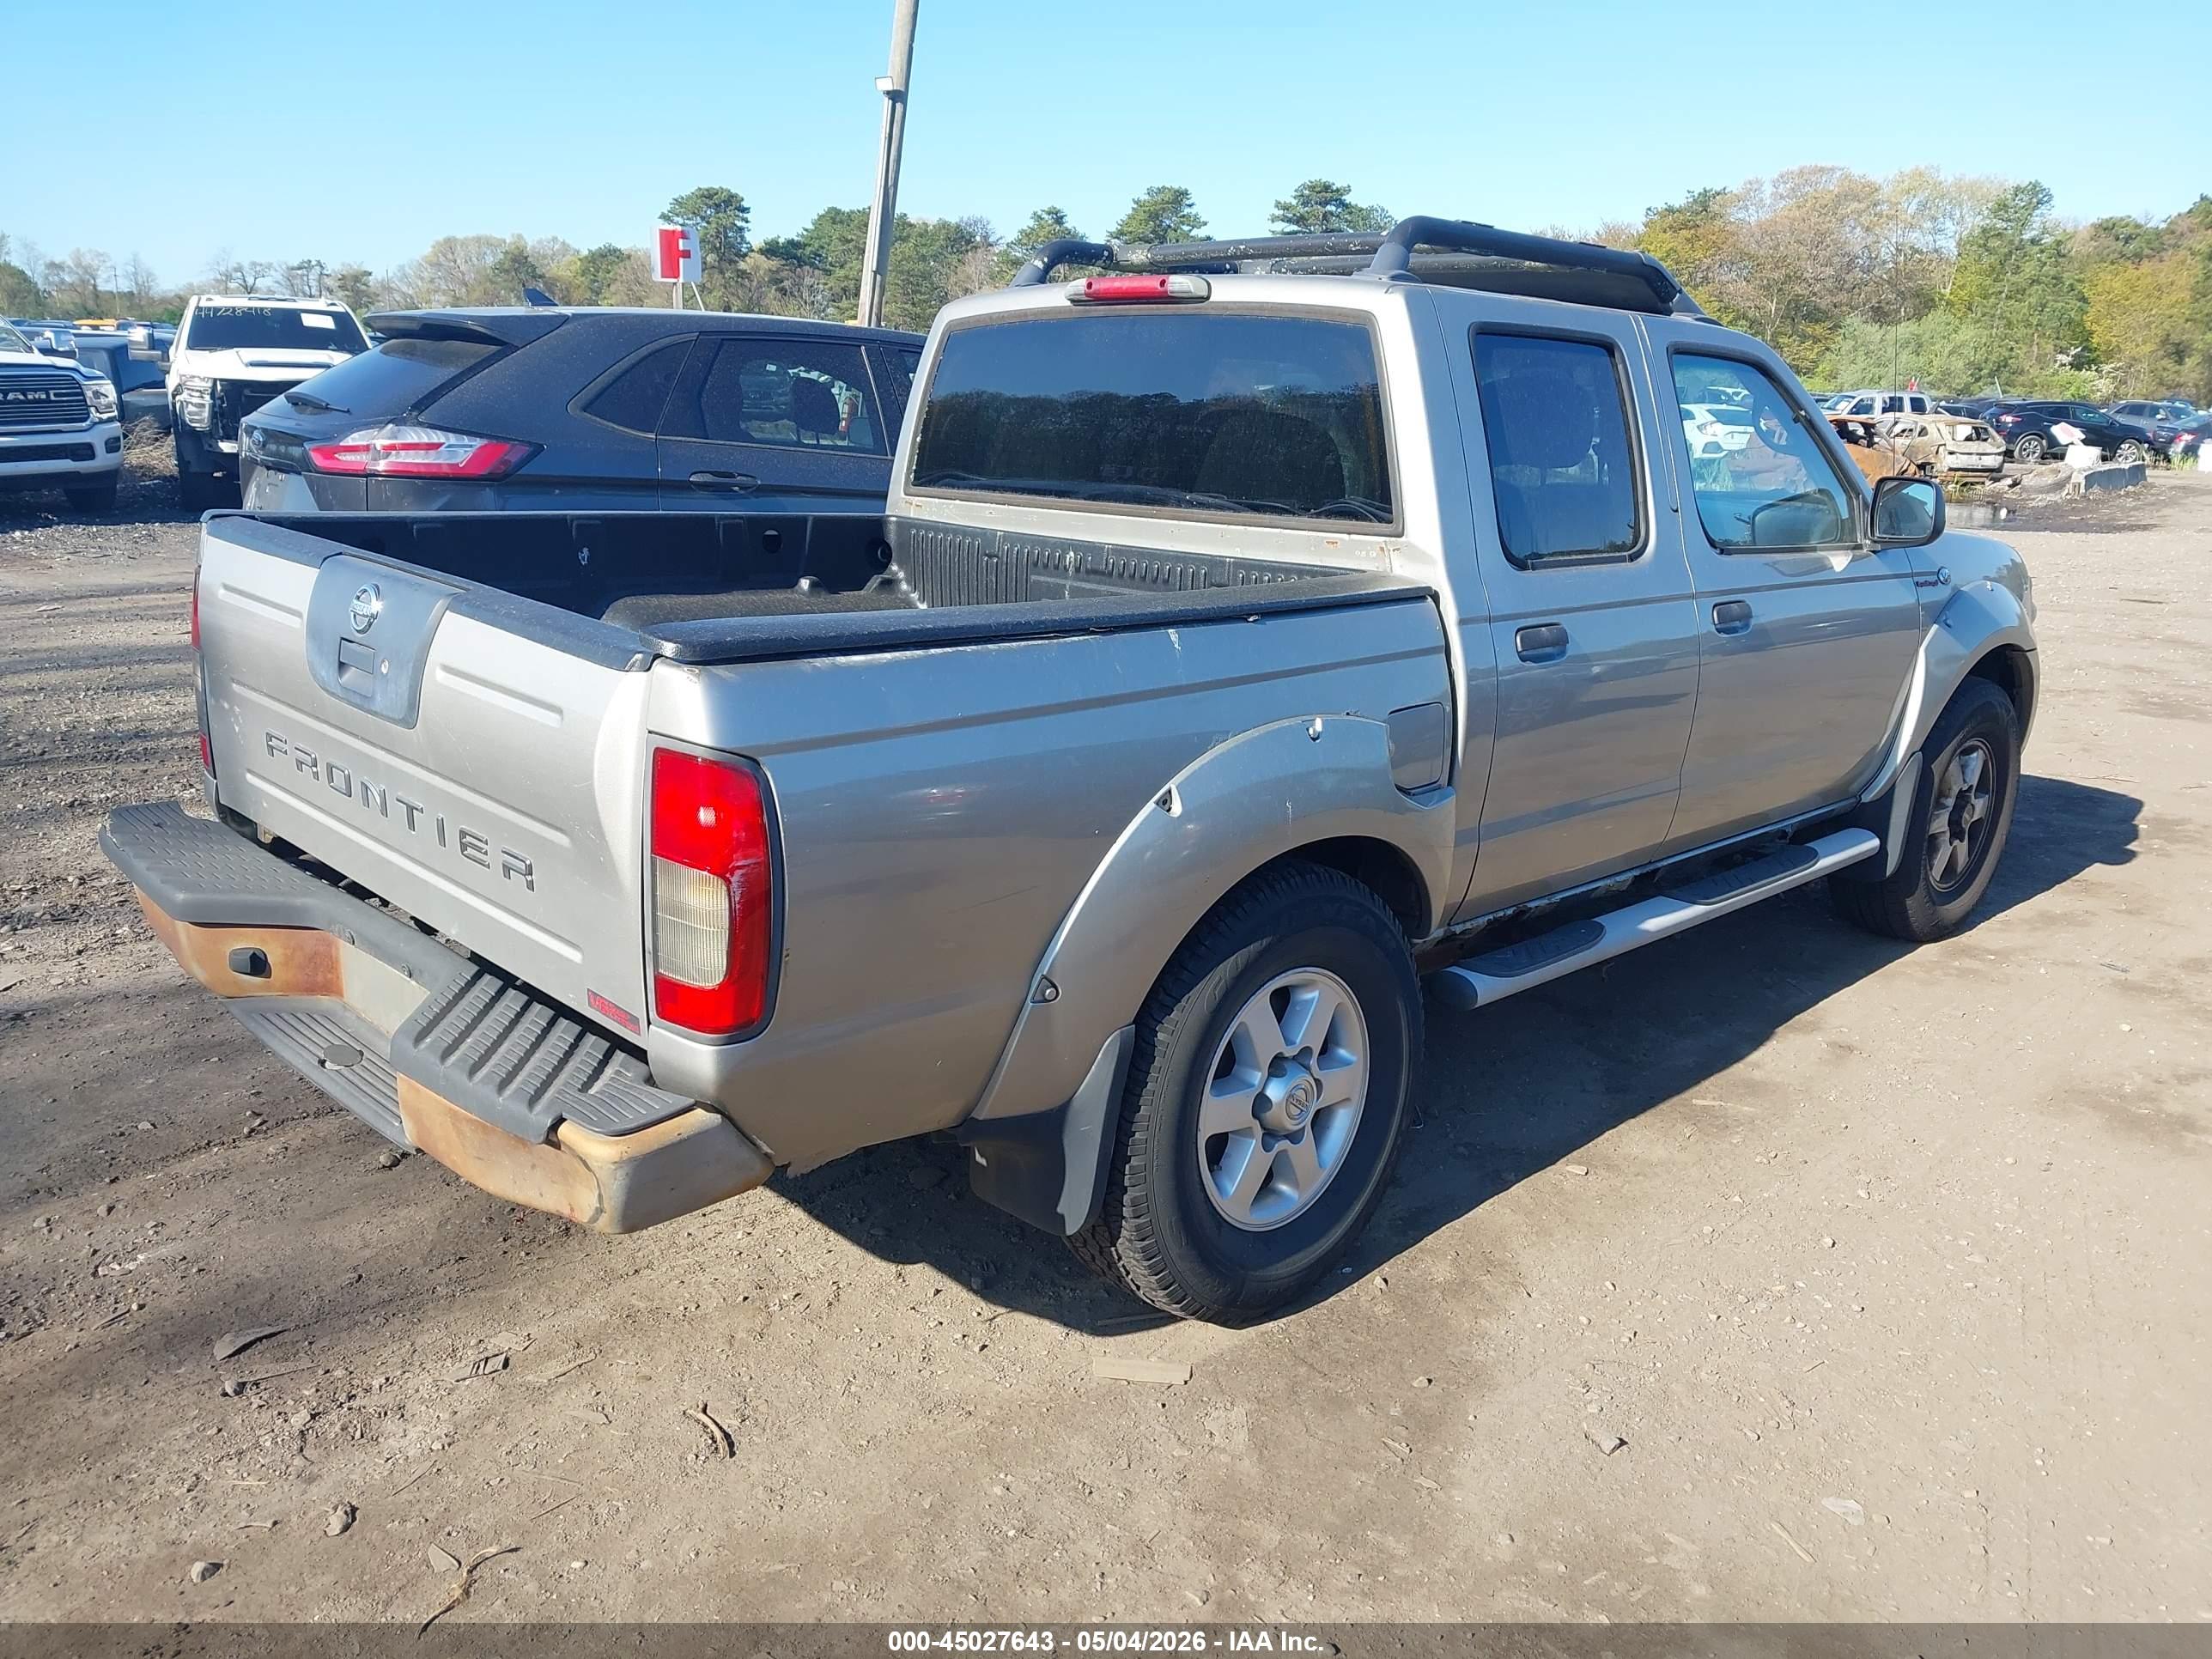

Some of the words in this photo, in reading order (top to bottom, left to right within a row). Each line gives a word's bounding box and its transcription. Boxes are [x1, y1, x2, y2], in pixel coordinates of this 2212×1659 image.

[659, 228, 691, 279] F
[0, 391, 46, 400] AM
[265, 732, 535, 892] FRONTIER
